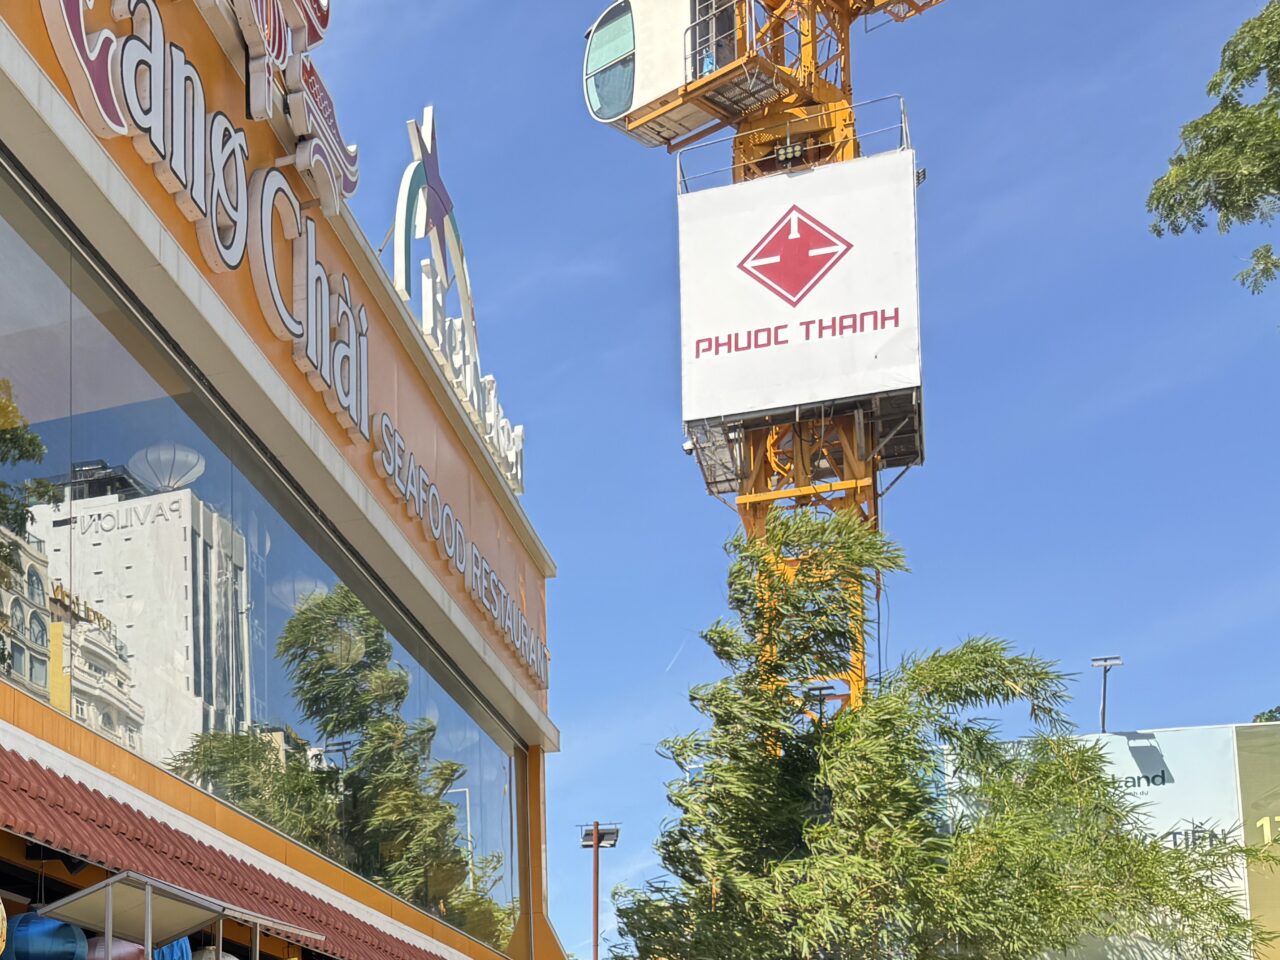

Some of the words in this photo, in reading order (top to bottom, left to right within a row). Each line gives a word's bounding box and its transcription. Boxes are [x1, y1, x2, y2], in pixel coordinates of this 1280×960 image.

[261, 166, 370, 441] Chài
[695, 324, 789, 359] PHUOC
[799, 307, 900, 341] THANH
[381, 413, 466, 574] SEAFOOD
[471, 542, 550, 687] RESTAURANT
